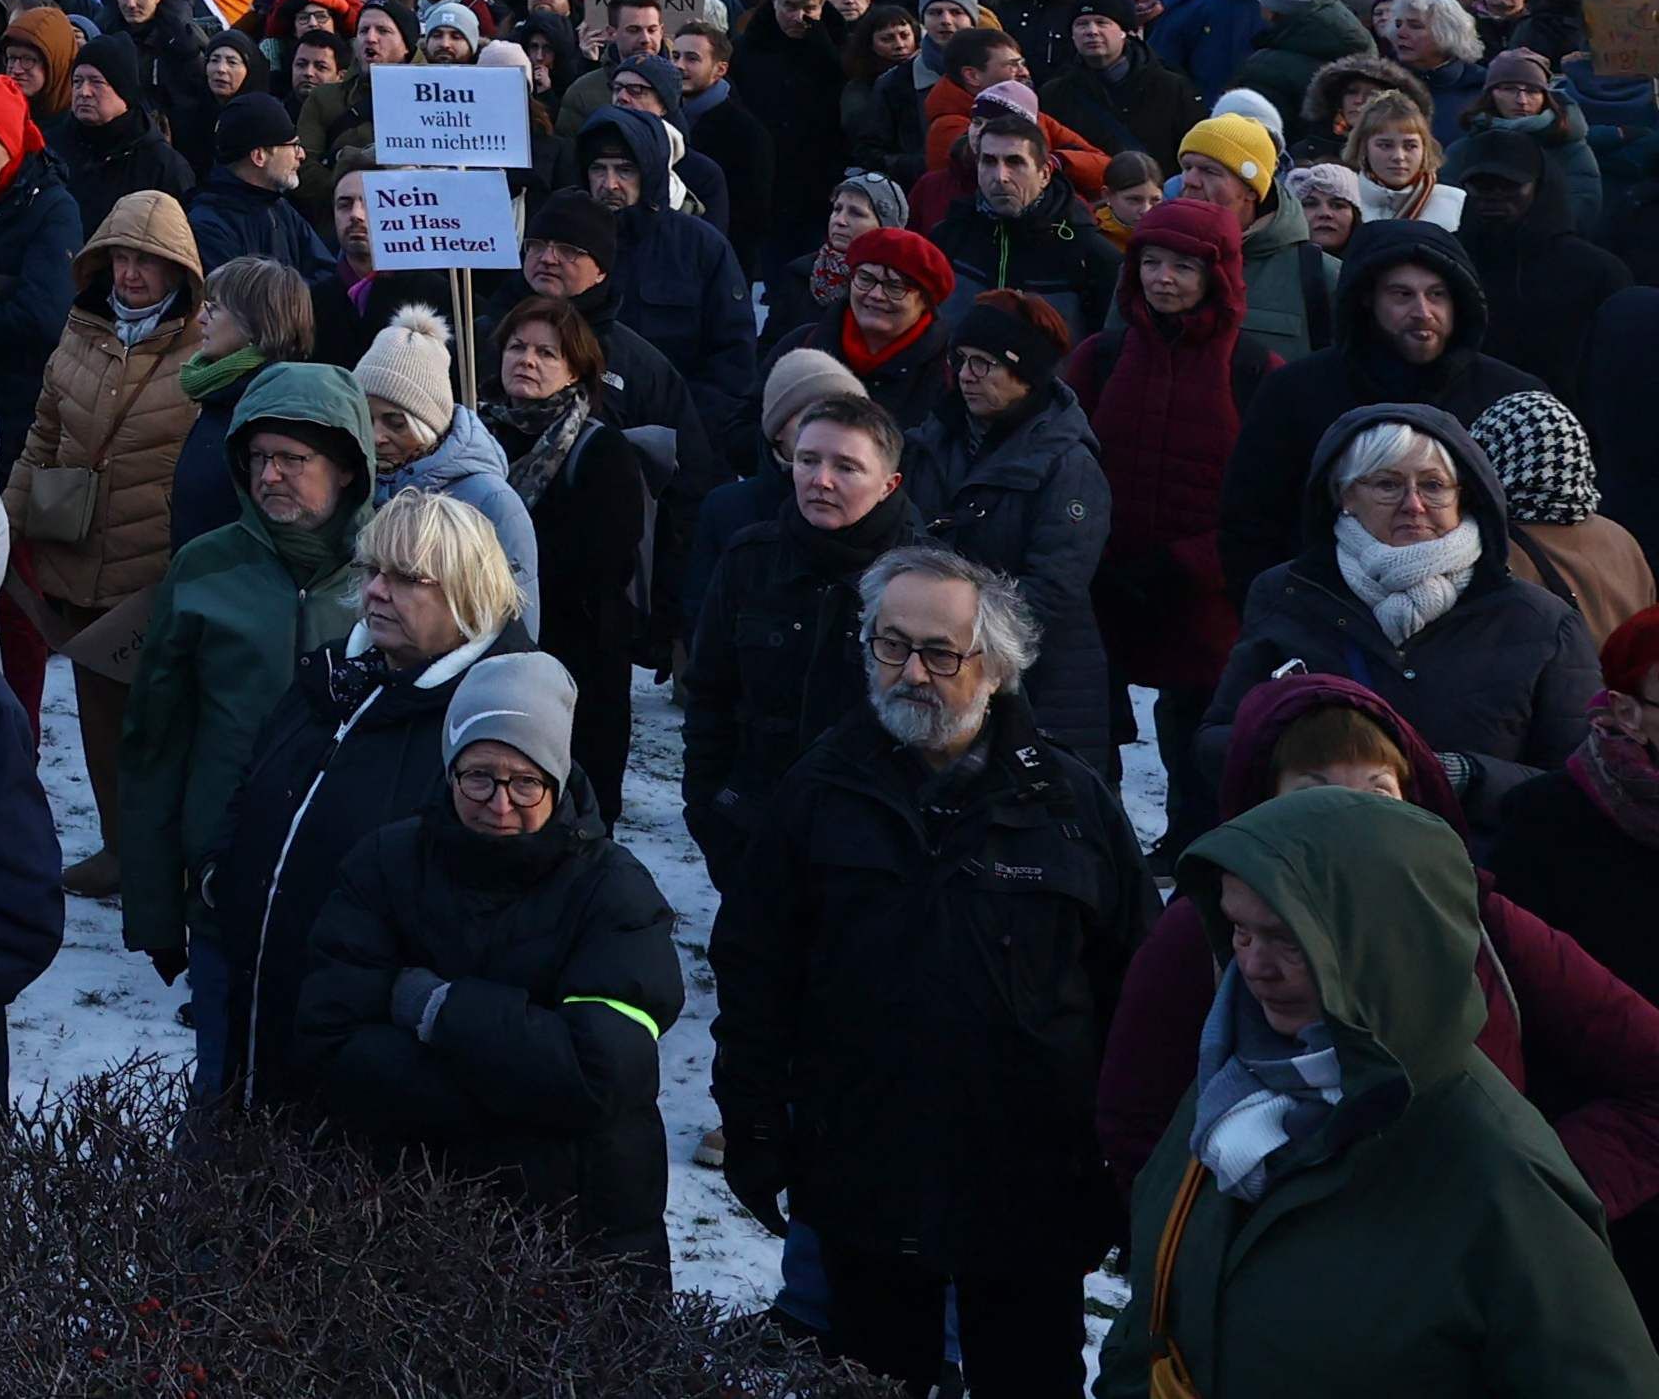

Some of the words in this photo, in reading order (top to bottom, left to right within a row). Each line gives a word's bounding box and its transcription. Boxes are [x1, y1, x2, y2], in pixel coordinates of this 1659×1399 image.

[413, 83, 476, 104] Blau
[420, 110, 473, 129] wählt
[385, 135, 425, 150] man
[430, 130, 508, 151] nicht!!!!
[376, 185, 439, 211] Nein
[379, 217, 405, 232] zu
[409, 212, 462, 232] Hass
[383, 234, 425, 253] und
[430, 232, 498, 253] Hetze!
